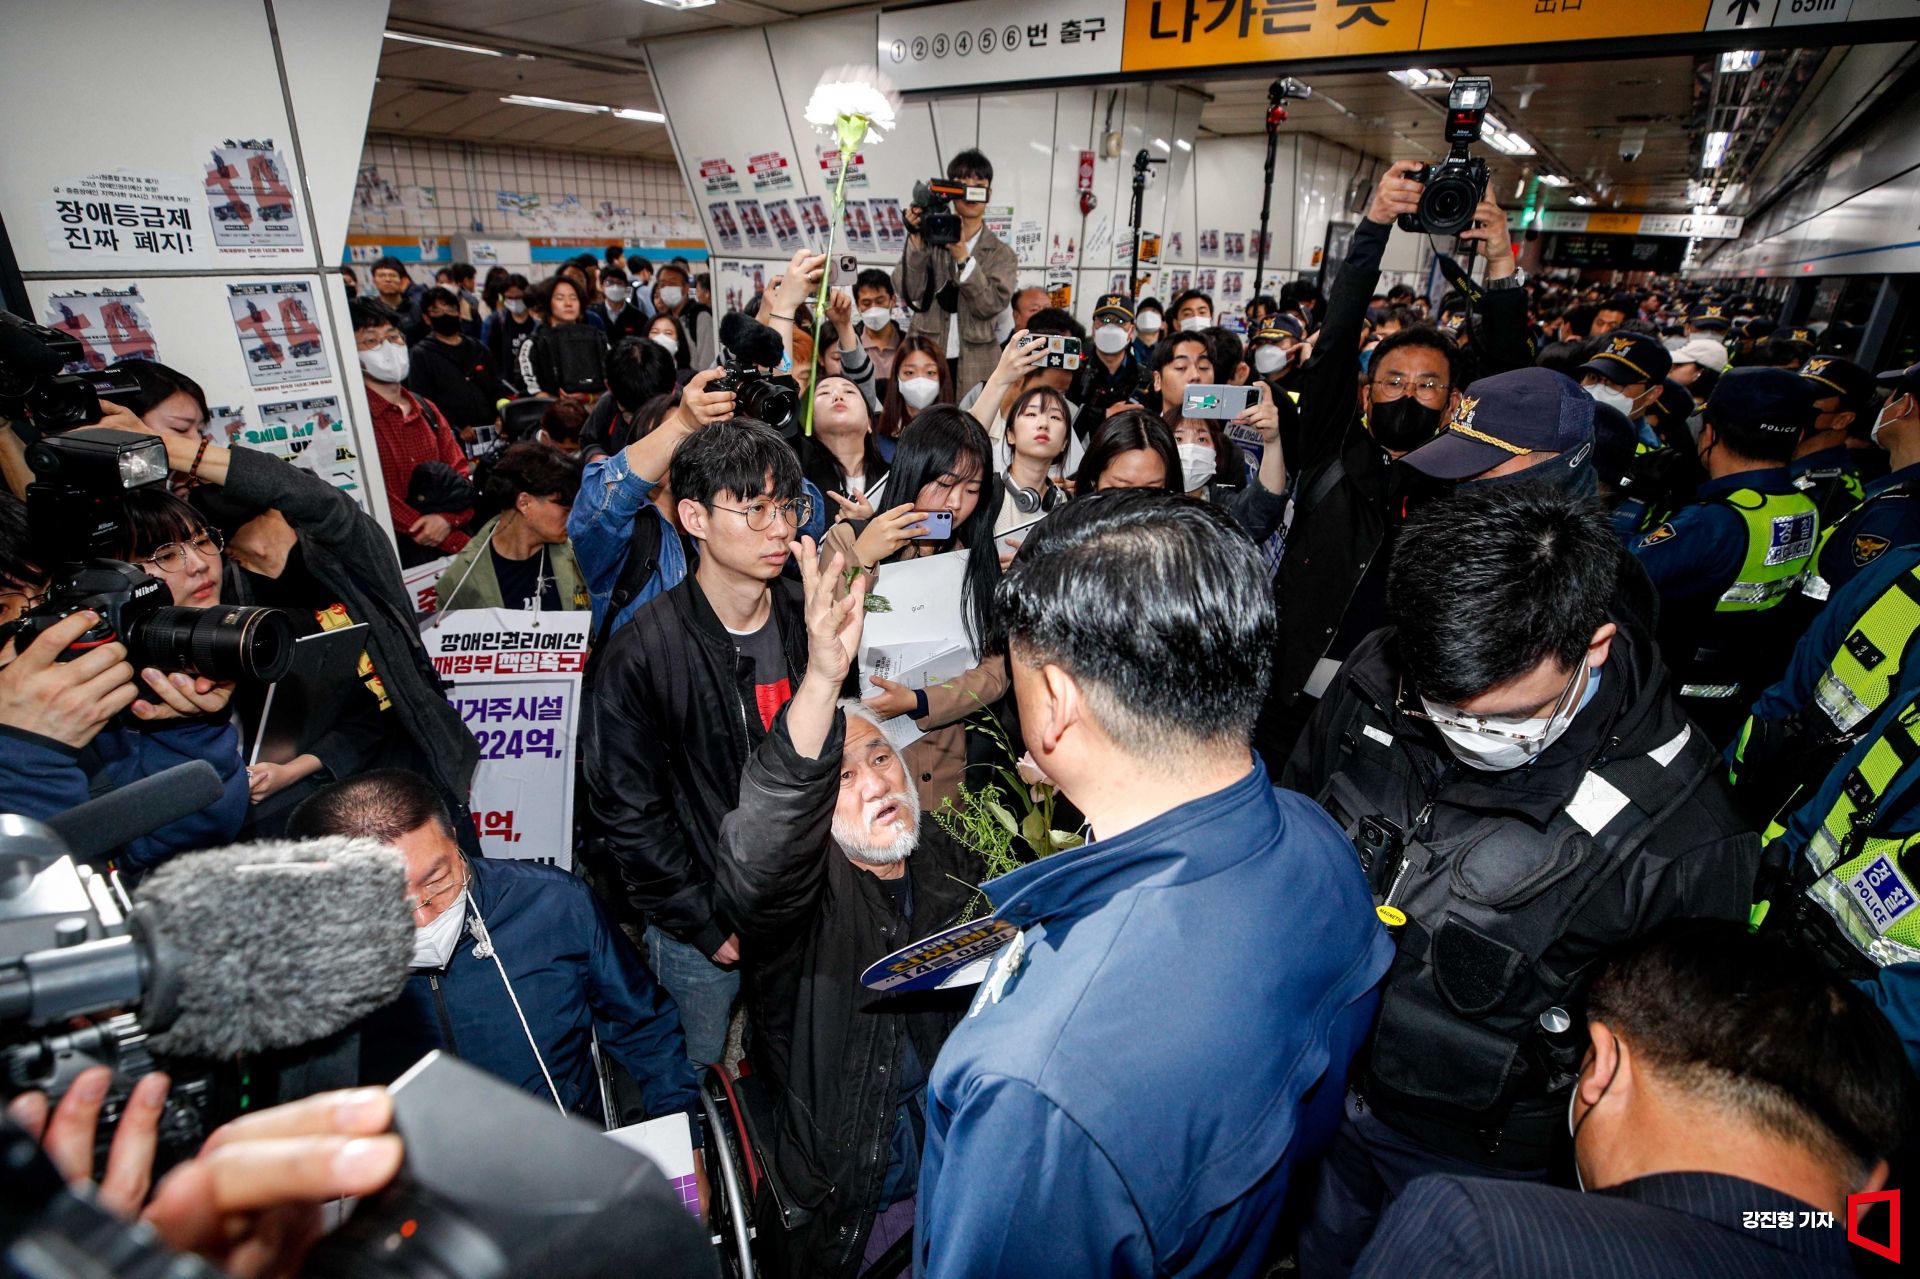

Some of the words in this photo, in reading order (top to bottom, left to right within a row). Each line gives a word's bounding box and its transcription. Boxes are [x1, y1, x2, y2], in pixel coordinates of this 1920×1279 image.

[1060, 17, 1106, 44] 출구
[1150, 0, 1317, 43] 나가는
[56, 200, 192, 230] 장애등급제
[63, 227, 120, 251] 진짜
[133, 231, 193, 254] 폐지!
[1760, 423, 1798, 433] POLICE
[1778, 516, 1811, 544] 경찰
[134, 583, 159, 598] Nikon
[441, 632, 584, 652] 장애인권리예산
[498, 652, 580, 673] 책임촉구
[1868, 861, 1910, 914] 경찰
[1379, 908, 1404, 924] MAGNETIC
[1854, 880, 1888, 925] POLICE
